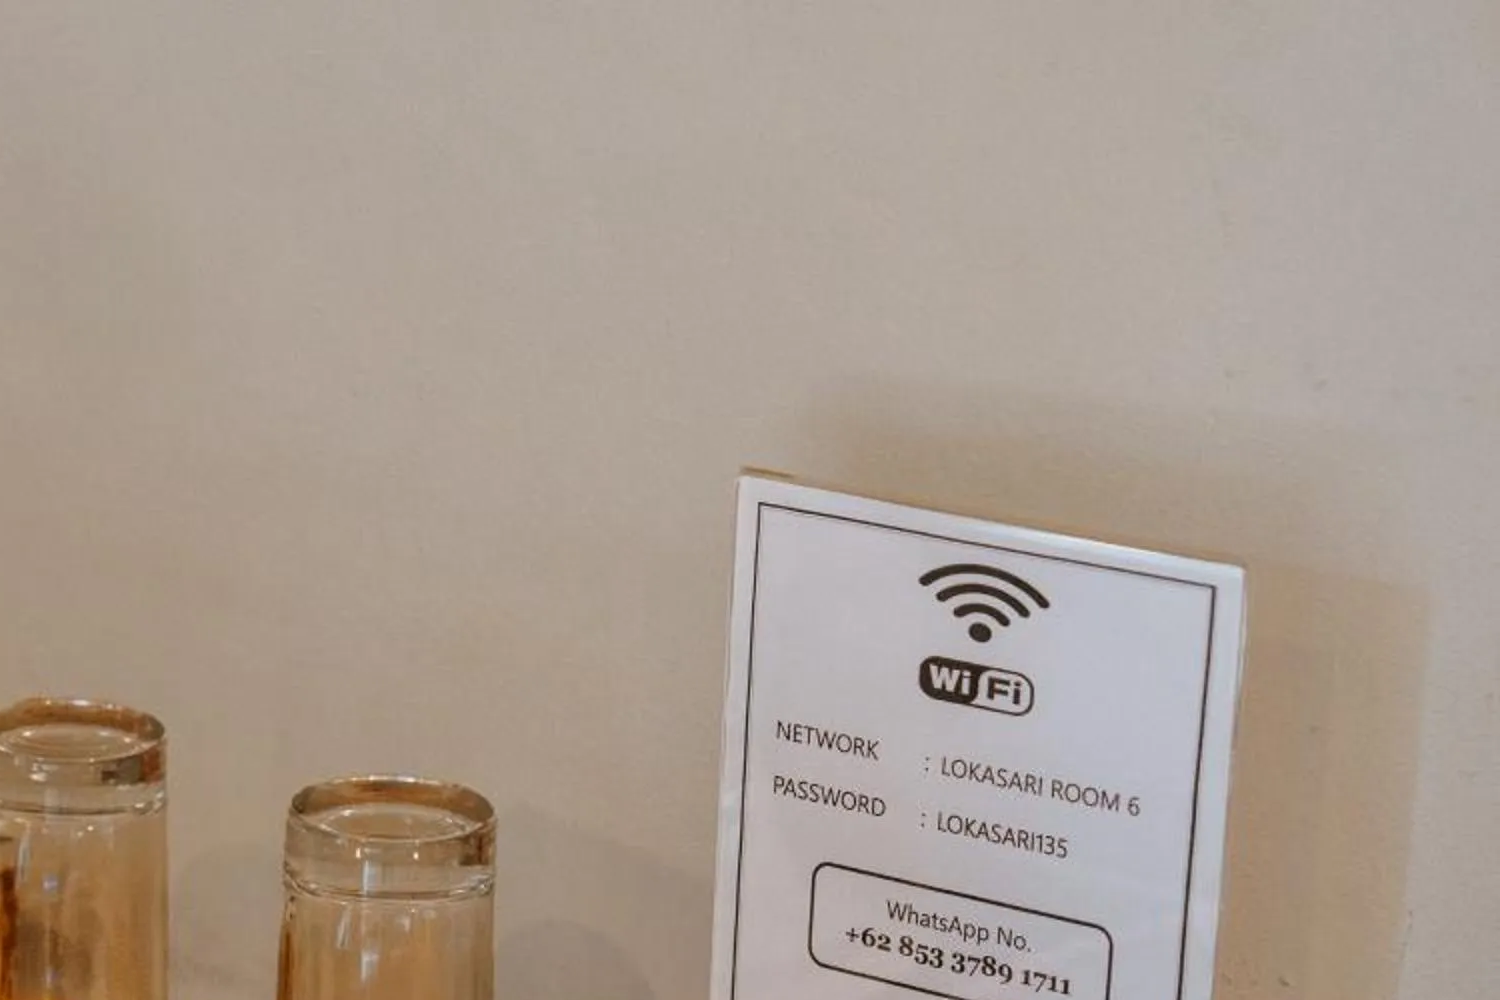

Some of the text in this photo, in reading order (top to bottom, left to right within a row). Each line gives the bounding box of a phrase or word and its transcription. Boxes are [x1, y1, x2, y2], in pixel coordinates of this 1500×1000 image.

[775, 719, 881, 761] NETWORK
[940, 756, 1044, 796] LOKASARI
[1050, 779, 1121, 813] ROOM
[1126, 796, 1141, 817] 6
[772, 774, 887, 817] PASSWORD
[936, 811, 1069, 860] LOKASARI135
[845, 927, 1073, 996] +62 853 3789 1711
[886, 900, 1032, 953] WhatsApp No.
